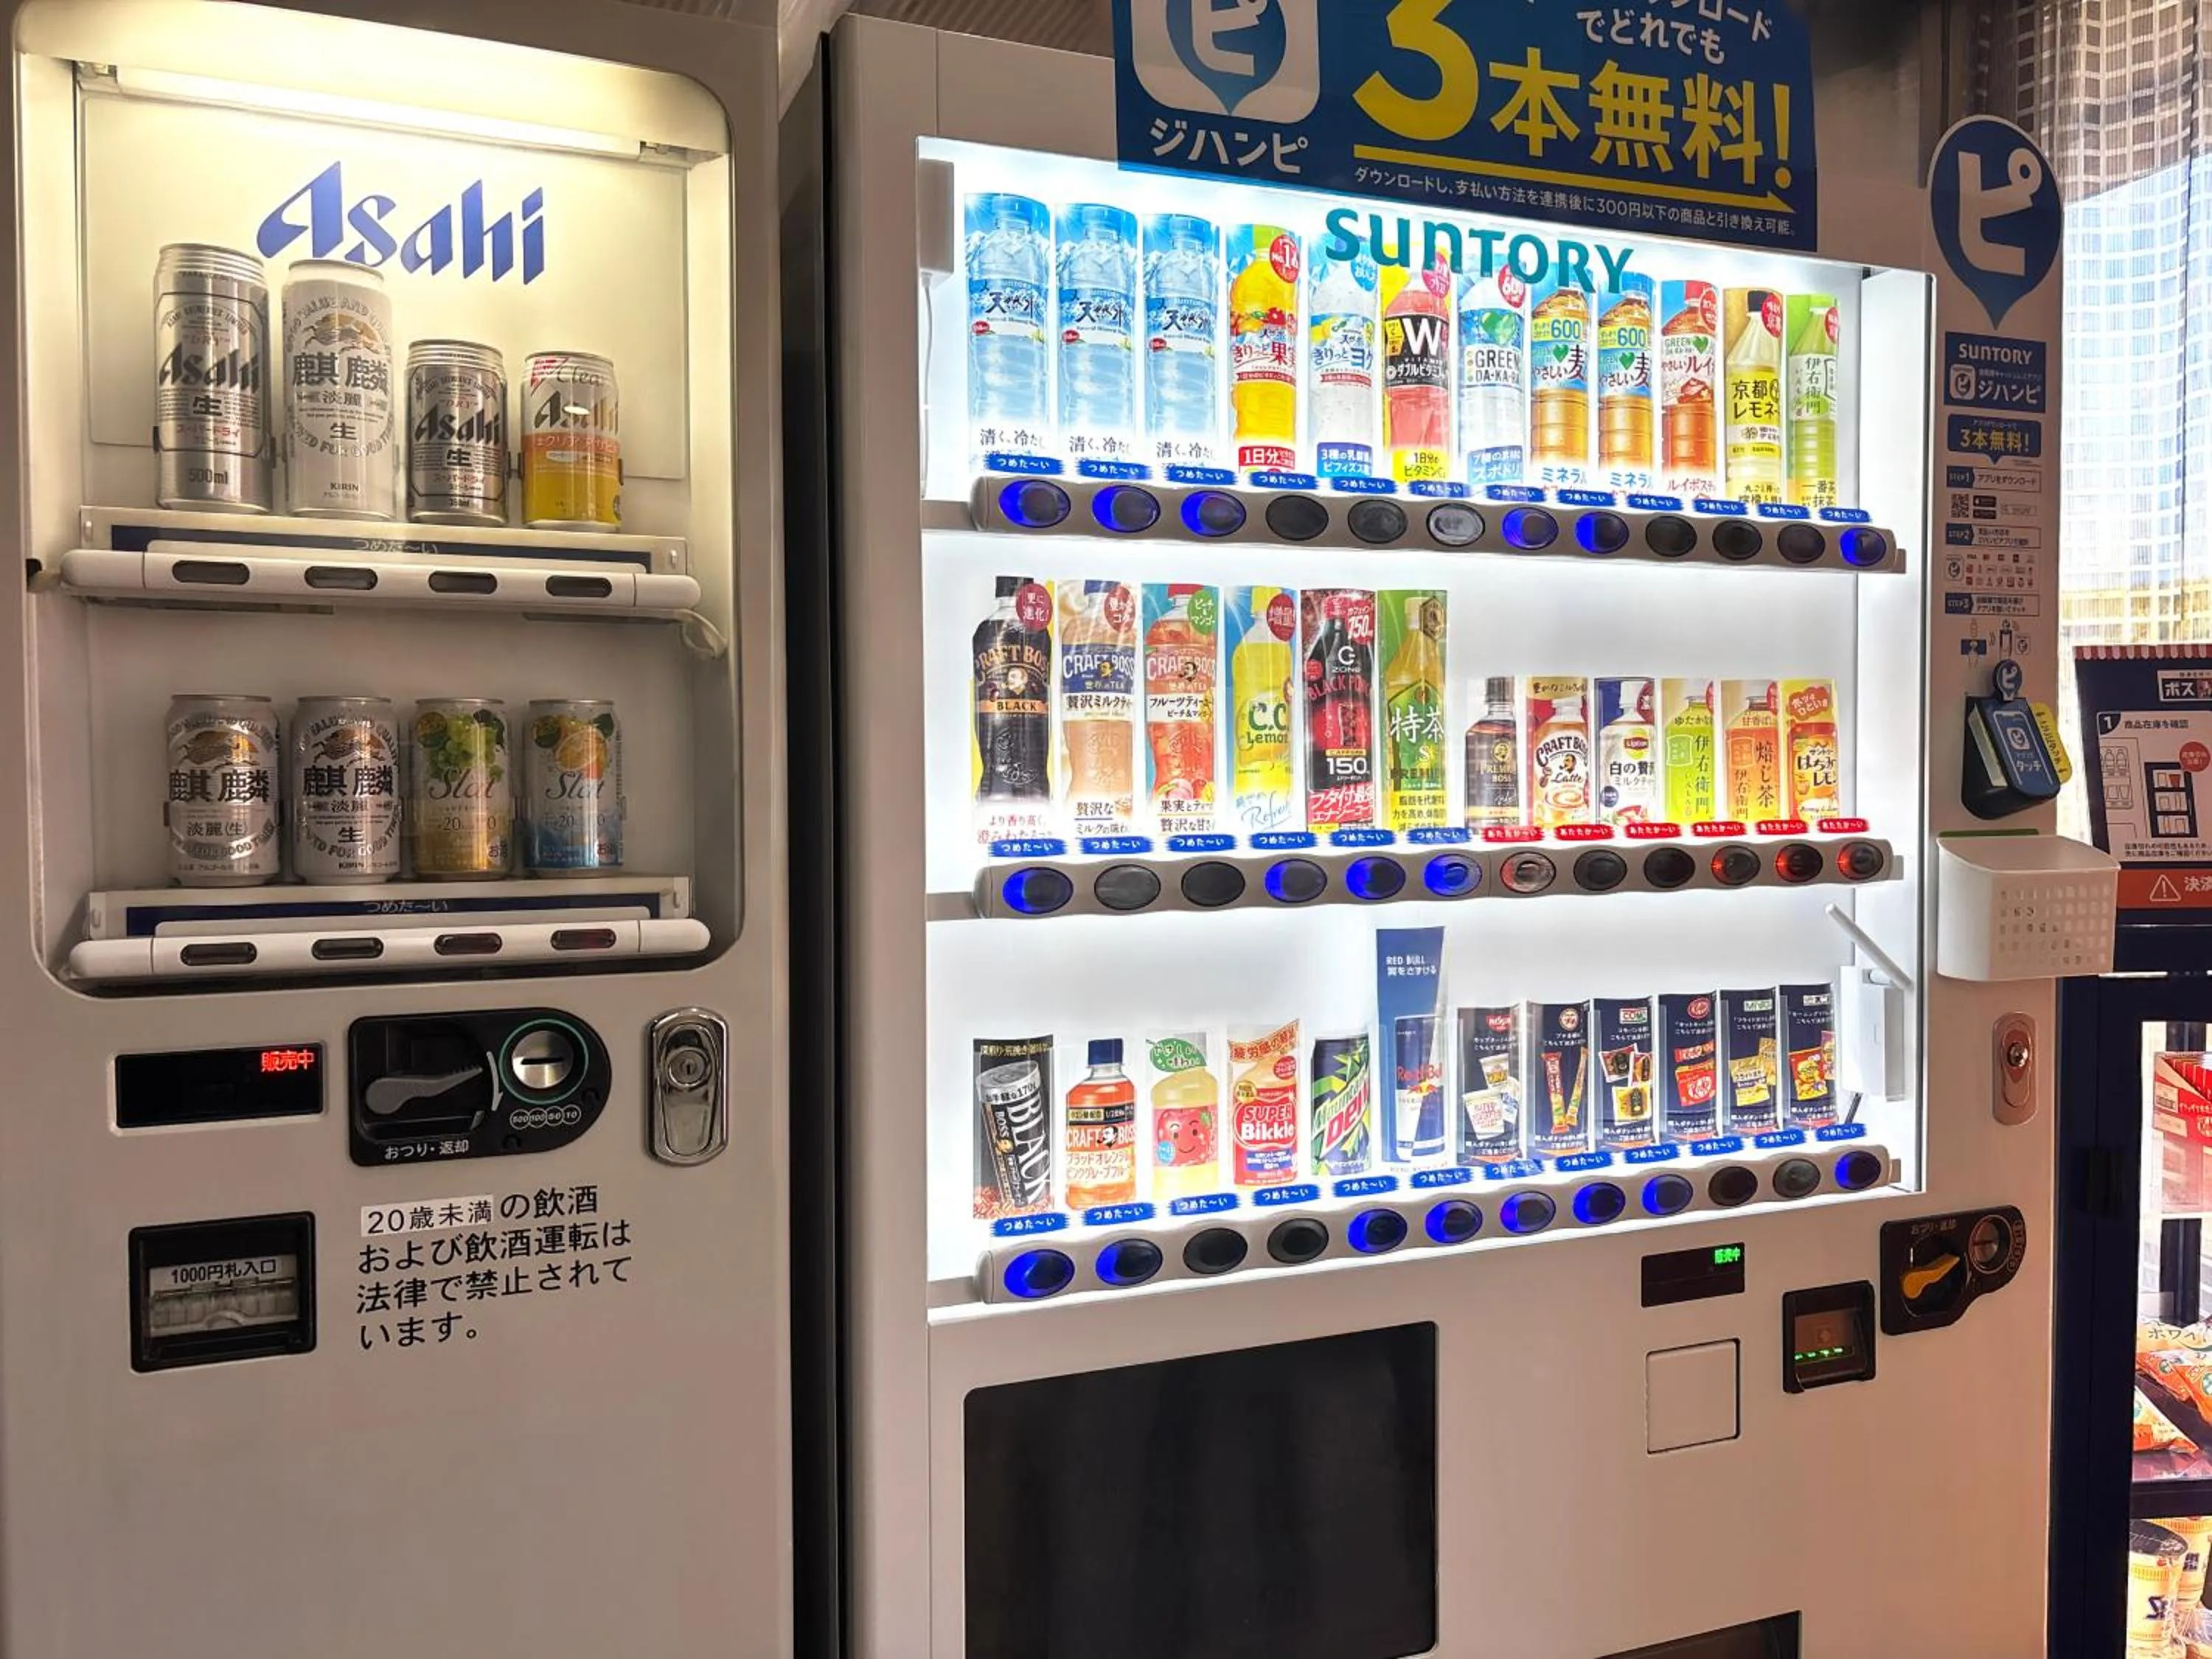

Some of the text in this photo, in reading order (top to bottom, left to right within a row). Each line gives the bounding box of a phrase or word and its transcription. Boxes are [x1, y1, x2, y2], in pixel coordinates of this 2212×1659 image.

[1576, 8, 1725, 64] でどれでも
[1150, 117, 1309, 173] ジハンピ
[256, 161, 545, 285] Asahi
[1957, 147, 2042, 276] ピ
[1325, 208, 1635, 294] SUNTORY
[984, 291, 1033, 319] 天然水
[1076, 300, 1123, 327] 天然水
[1403, 317, 1441, 357] W
[1551, 319, 1582, 339] 600
[1617, 327, 1647, 347] 600
[1475, 349, 1520, 369] GREEN
[1958, 343, 2032, 365] SUNTORY
[159, 342, 259, 394] Asahi
[293, 351, 389, 395] 麒麟
[1978, 380, 2041, 404] ジハンピ
[192, 395, 222, 417] 生
[330, 422, 358, 440] 生
[414, 404, 500, 445] Asahi
[1960, 428, 2029, 453] 3本無料!
[446, 449, 471, 467] 生
[188, 470, 229, 485] 500ml
[330, 481, 359, 492] KIRIN
[1062, 654, 1100, 679] CRAFT
[2164, 681, 2195, 698] ボス
[996, 700, 1037, 712] BLACK
[1390, 705, 1445, 744] 特茶
[2104, 716, 2112, 729] 1
[2124, 719, 2189, 729] 商品在庫を確認
[1536, 736, 1571, 766] CRAFT
[1326, 757, 1368, 775] 150
[1694, 734, 1710, 814] 伊右衛門
[1756, 740, 1775, 808] 焙じ茶
[2016, 759, 2042, 772] タッチ
[169, 769, 270, 802] 麒麟
[302, 765, 394, 798] 麒麟
[1551, 772, 1583, 785] Latte
[338, 827, 364, 844] 生
[1385, 955, 1425, 966] RED BULL
[260, 1050, 316, 1072] 販売中
[995, 1110, 1010, 1138] BOSS
[1243, 1104, 1293, 1121] SUPER
[1067, 1127, 1100, 1148] CRAFT
[1241, 1121, 1295, 1141] Bikkle
[383, 1140, 470, 1161] おつり・返却
[1006, 1094, 1051, 1204] BLACK
[367, 1185, 598, 1234] 20歳未満 の飲酒
[358, 1219, 631, 1275] および飲酒運転は
[170, 1259, 277, 1284] 1000円札入口
[356, 1256, 632, 1314] 法律で禁止されて
[360, 1310, 478, 1350] います。
